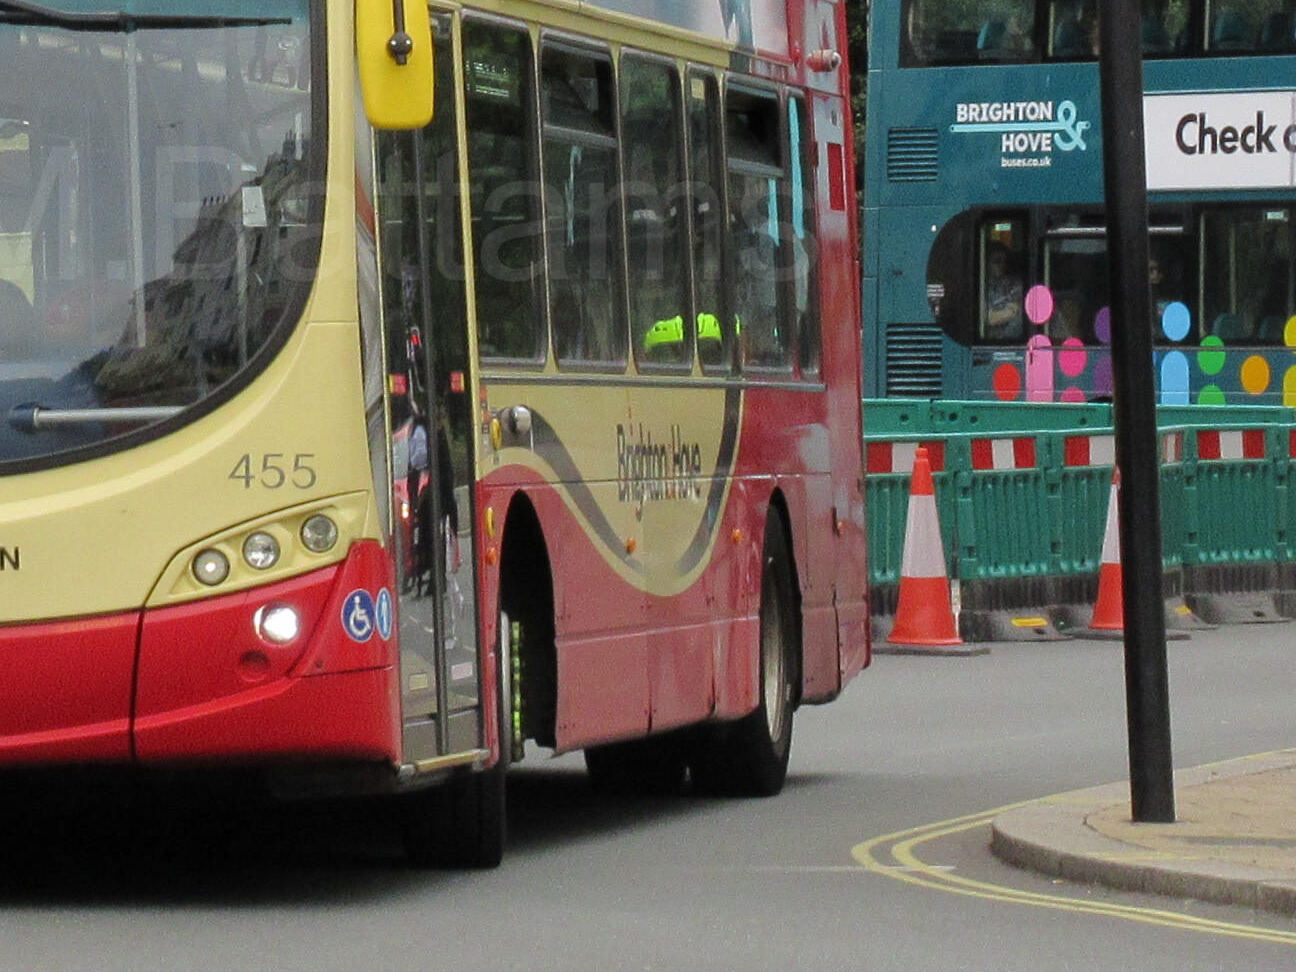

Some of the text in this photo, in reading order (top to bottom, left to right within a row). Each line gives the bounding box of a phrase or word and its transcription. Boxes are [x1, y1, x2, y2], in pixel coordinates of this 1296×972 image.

[956, 101, 1052, 122] BRIGHTON
[1001, 133, 1052, 152] HOVE
[1175, 110, 1278, 155] Check
[1000, 156, 1051, 167] buses.co.uk
[228, 453, 317, 489] 455
